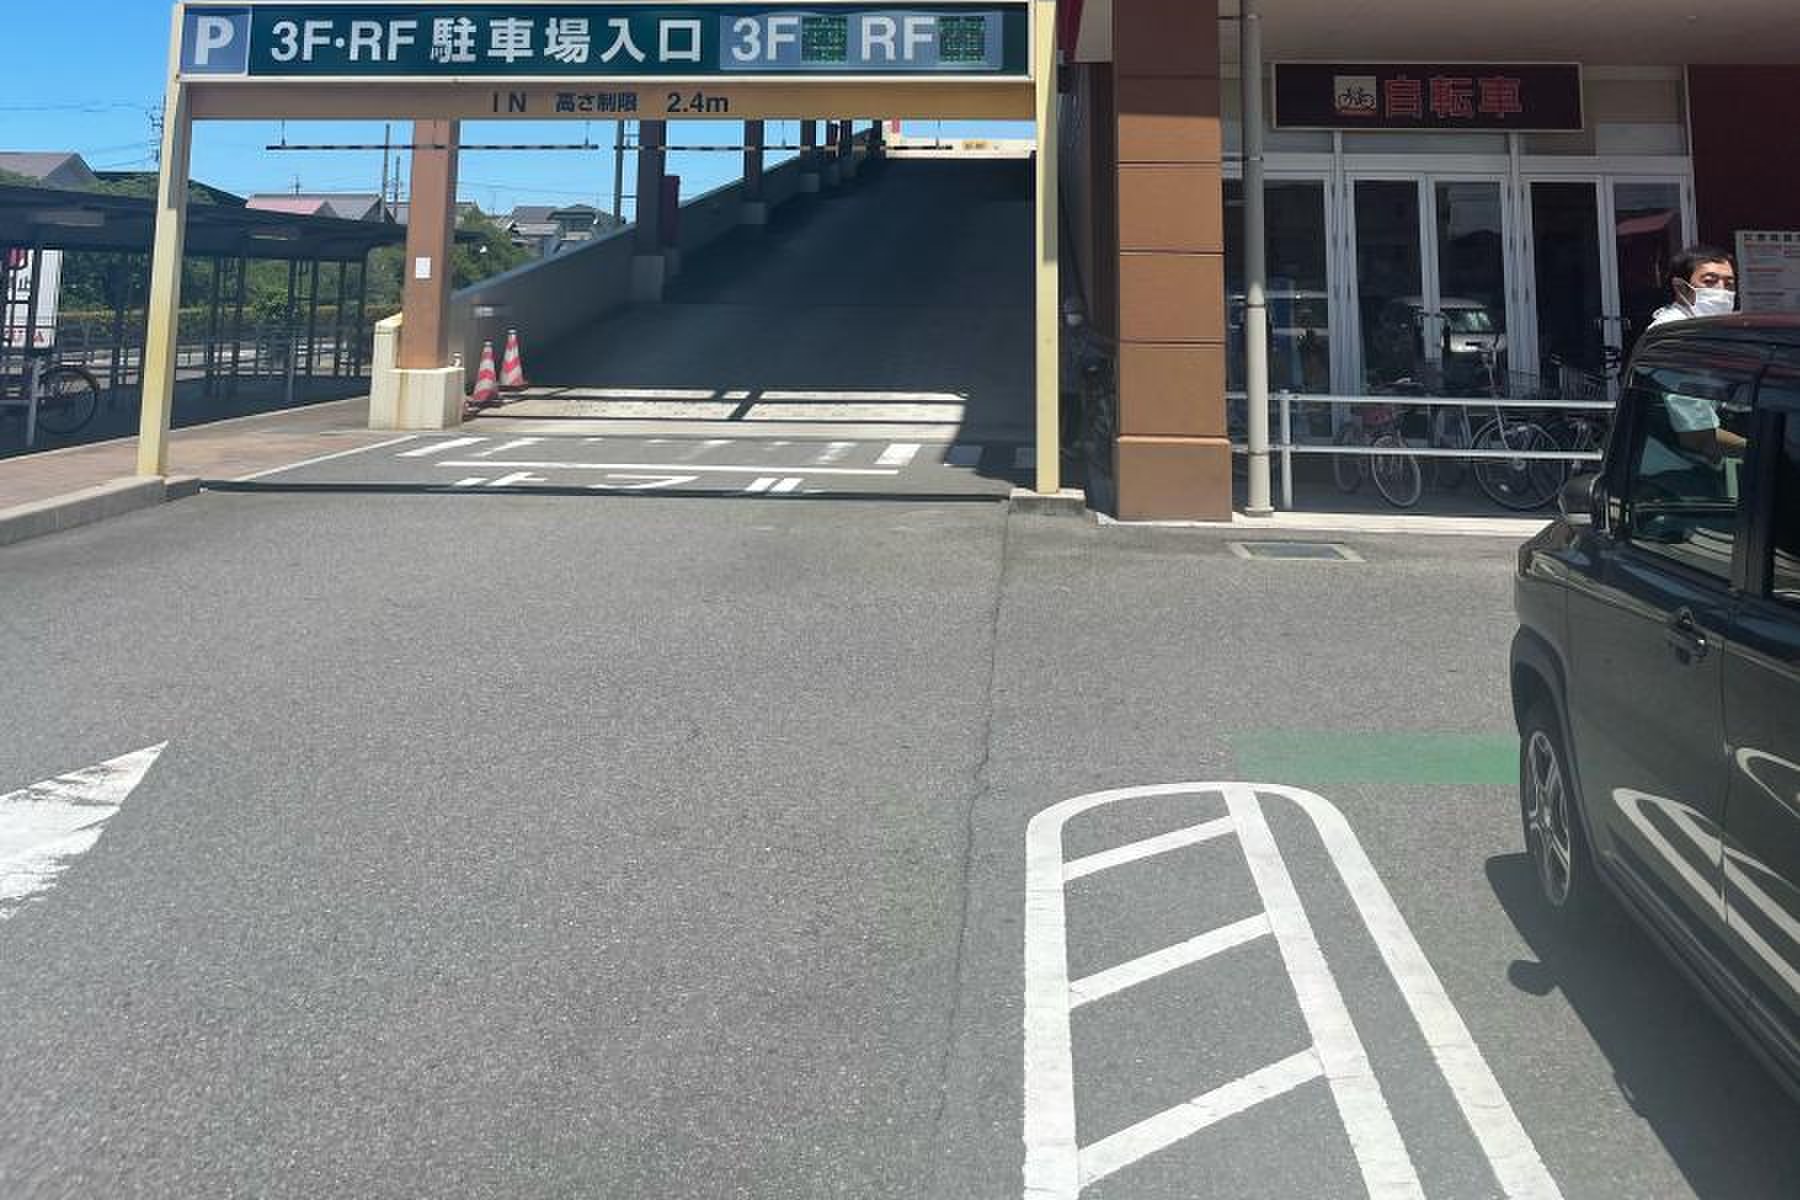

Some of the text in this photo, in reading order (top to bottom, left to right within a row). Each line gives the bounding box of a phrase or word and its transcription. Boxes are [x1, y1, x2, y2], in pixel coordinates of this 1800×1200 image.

[195, 16, 234, 64] P
[732, 17, 798, 61] 3F
[861, 16, 936, 61] RF
[492, 92, 729, 113] IN 高さ制限 2.4m
[1384, 74, 1522, 118] 自転車
